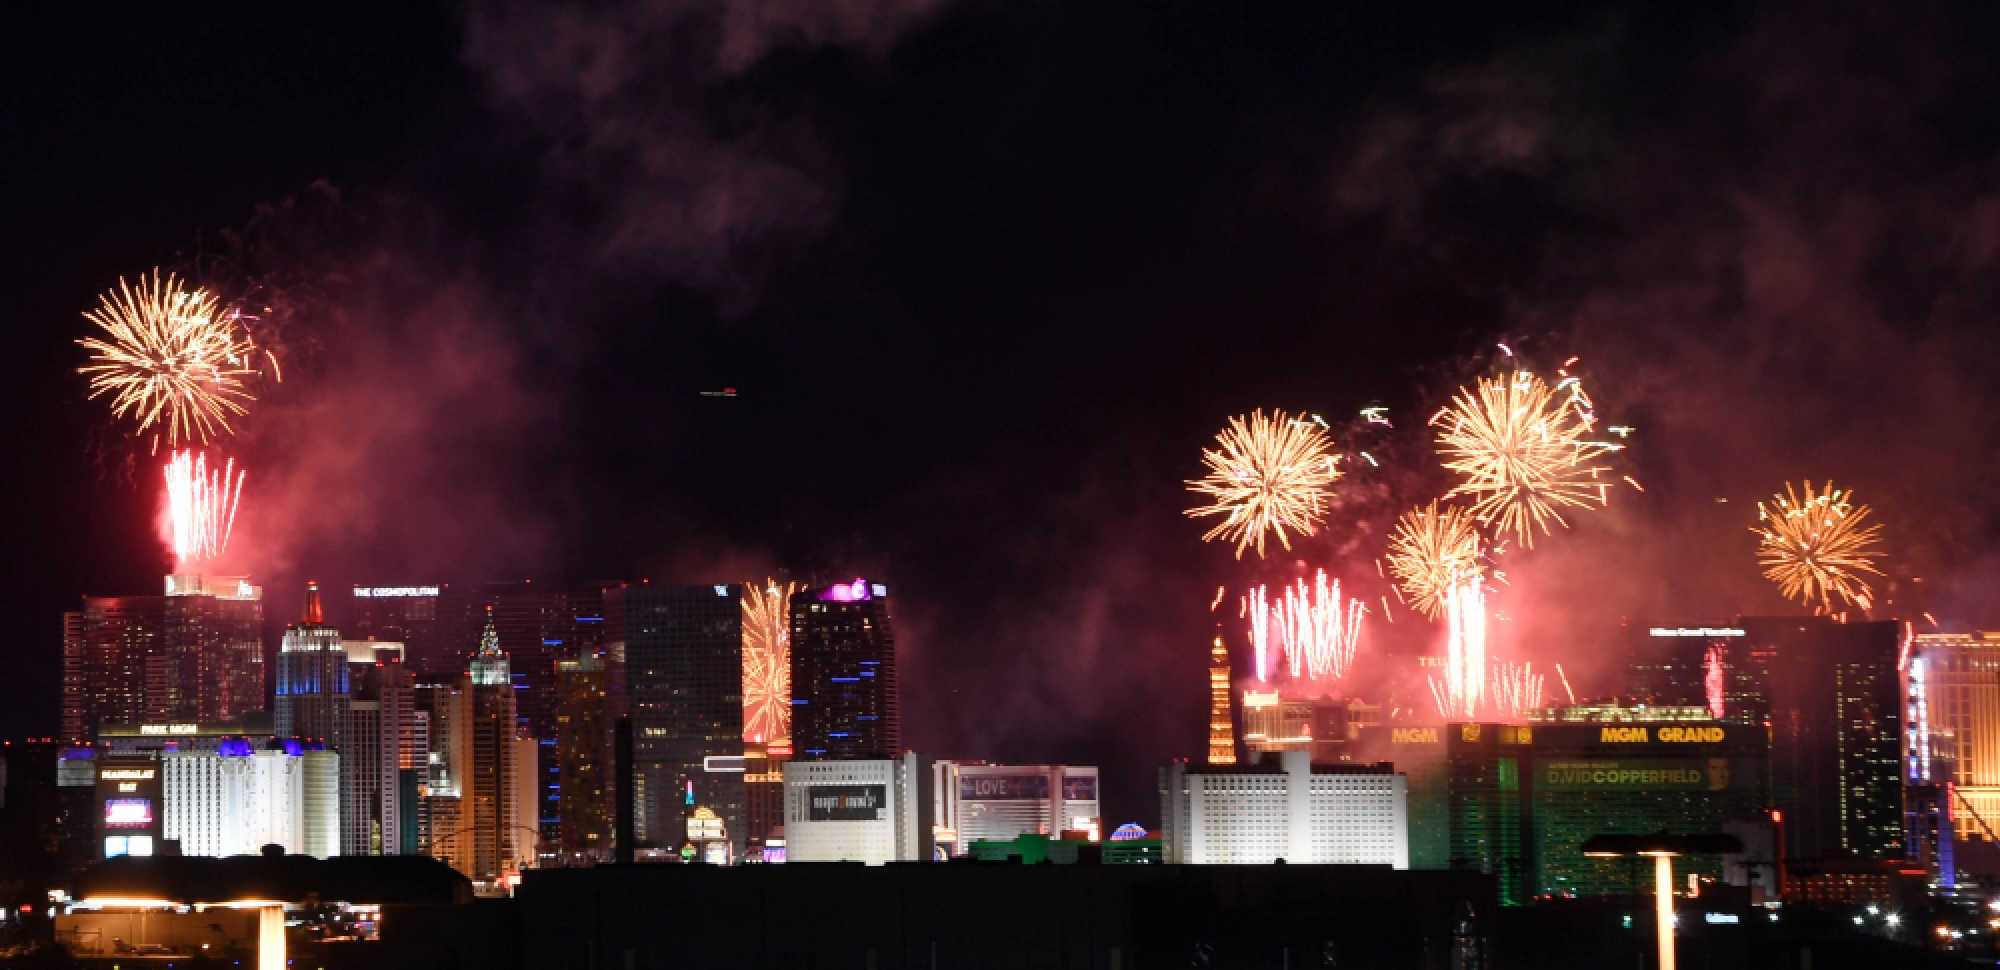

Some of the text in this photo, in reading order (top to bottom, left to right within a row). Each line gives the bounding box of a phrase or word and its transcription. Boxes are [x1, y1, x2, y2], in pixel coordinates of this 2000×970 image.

[1392, 727, 1438, 743] MGM
[1601, 727, 1725, 743] MGM GRAND
[975, 779, 1007, 795] LOVE
